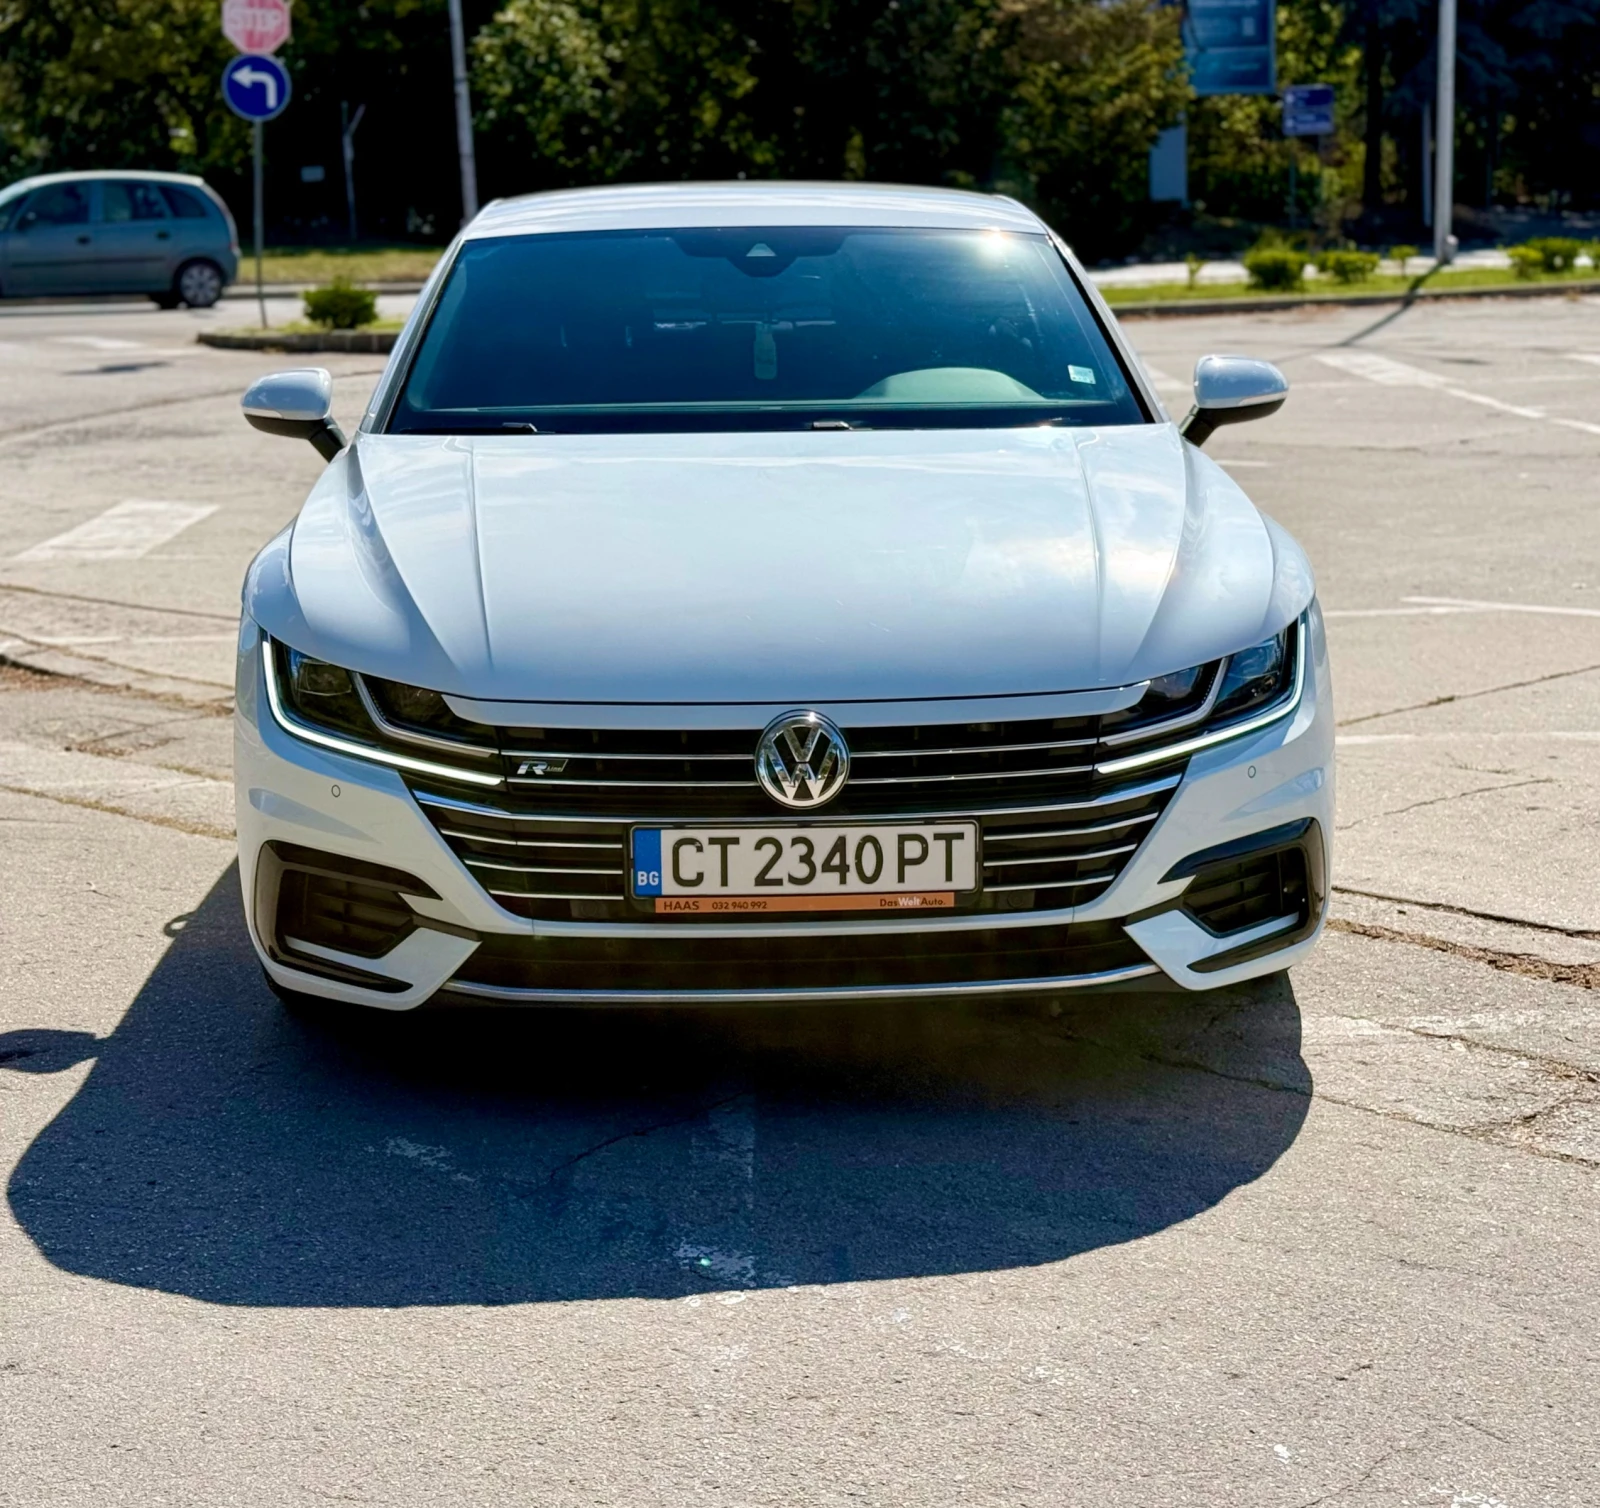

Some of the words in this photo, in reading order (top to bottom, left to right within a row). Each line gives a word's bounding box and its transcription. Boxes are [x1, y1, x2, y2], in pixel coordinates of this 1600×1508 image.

[228, 8, 283, 31] STOP
[671, 836, 740, 888] CT
[753, 835, 884, 887] 2340
[897, 832, 965, 884] PT
[637, 870, 660, 886] BG
[663, 900, 700, 911] HAAS
[711, 901, 730, 910] 032
[731, 901, 749, 910] 940
[750, 901, 768, 910] 992
